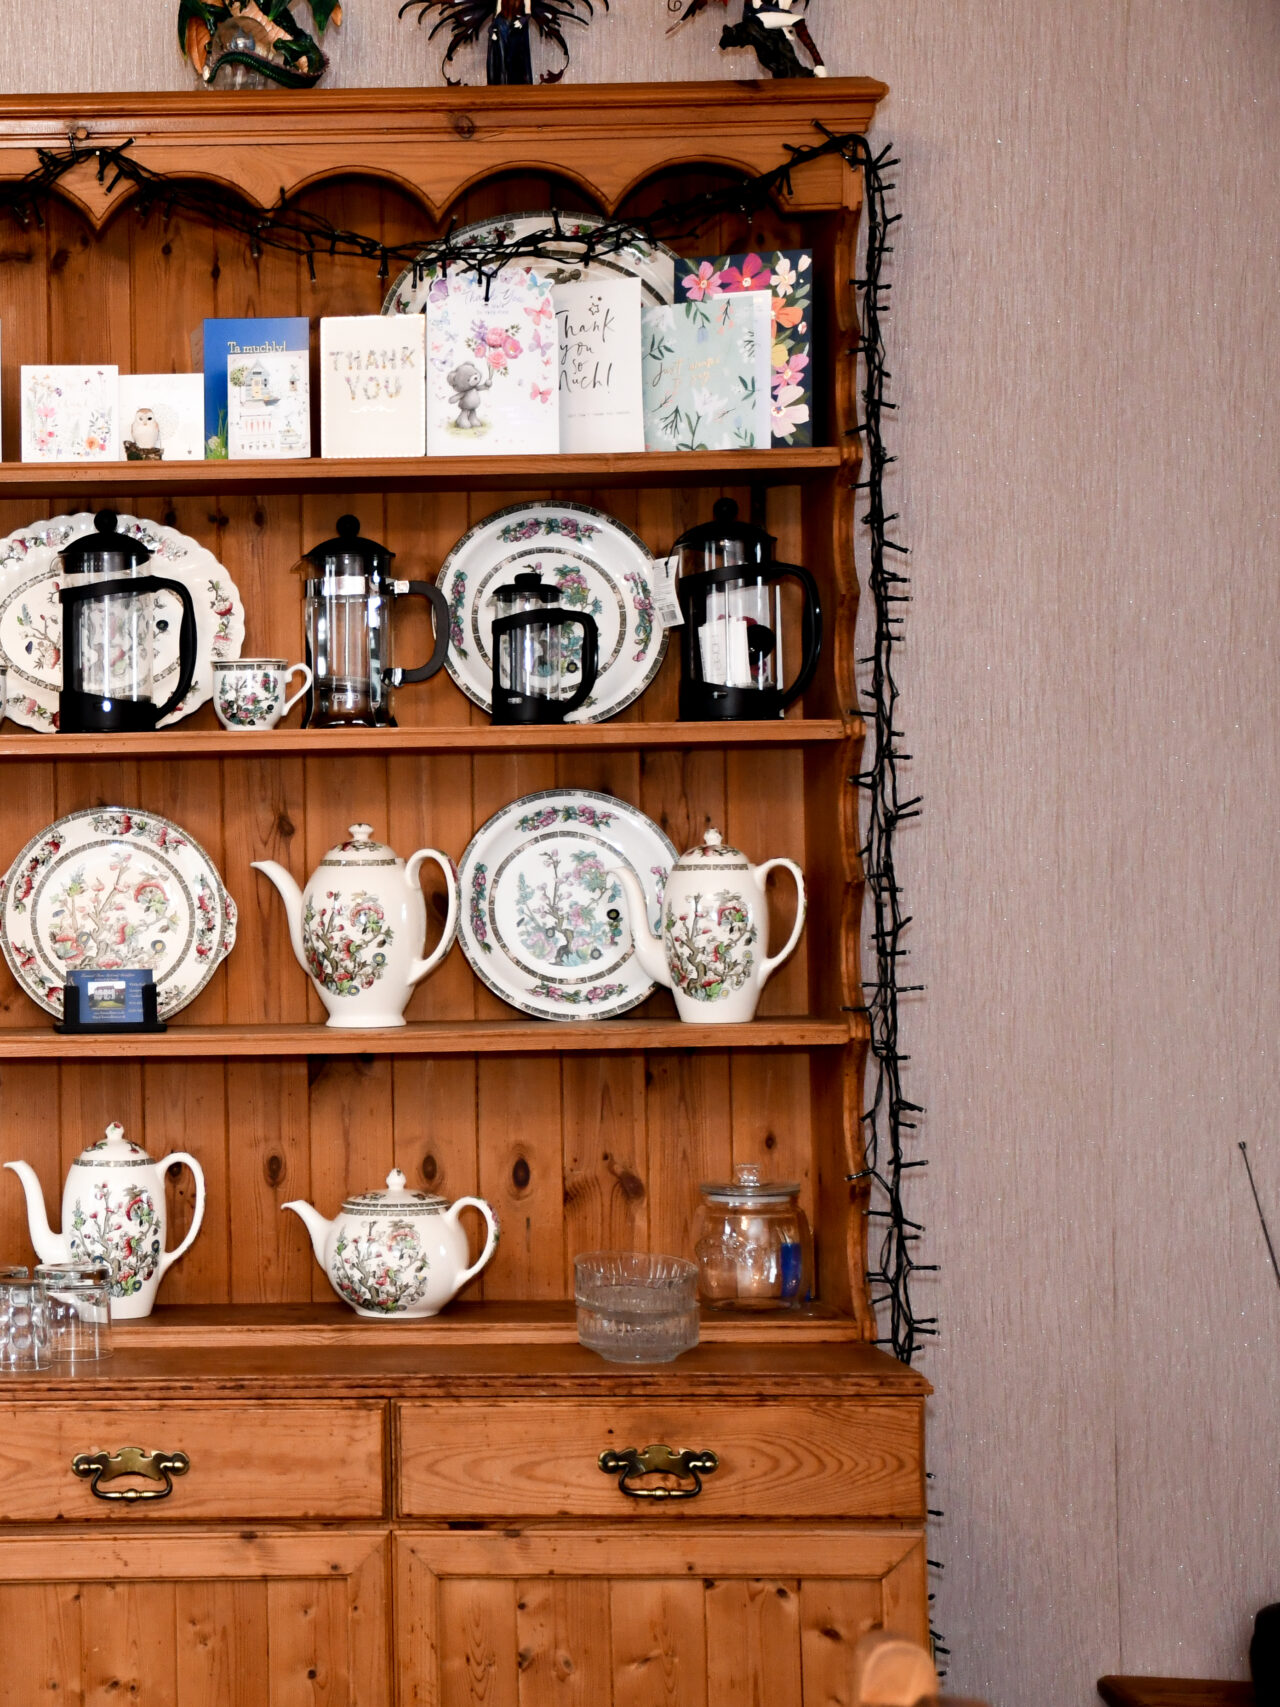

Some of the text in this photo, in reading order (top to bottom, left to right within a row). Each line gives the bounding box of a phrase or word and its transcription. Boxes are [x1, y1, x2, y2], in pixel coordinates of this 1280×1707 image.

[555, 308, 615, 343] Thank
[227, 341, 240, 354] Ta
[328, 345, 416, 372] THANK
[559, 342, 595, 365] you
[572, 358, 588, 374] so
[344, 375, 402, 401] YOU
